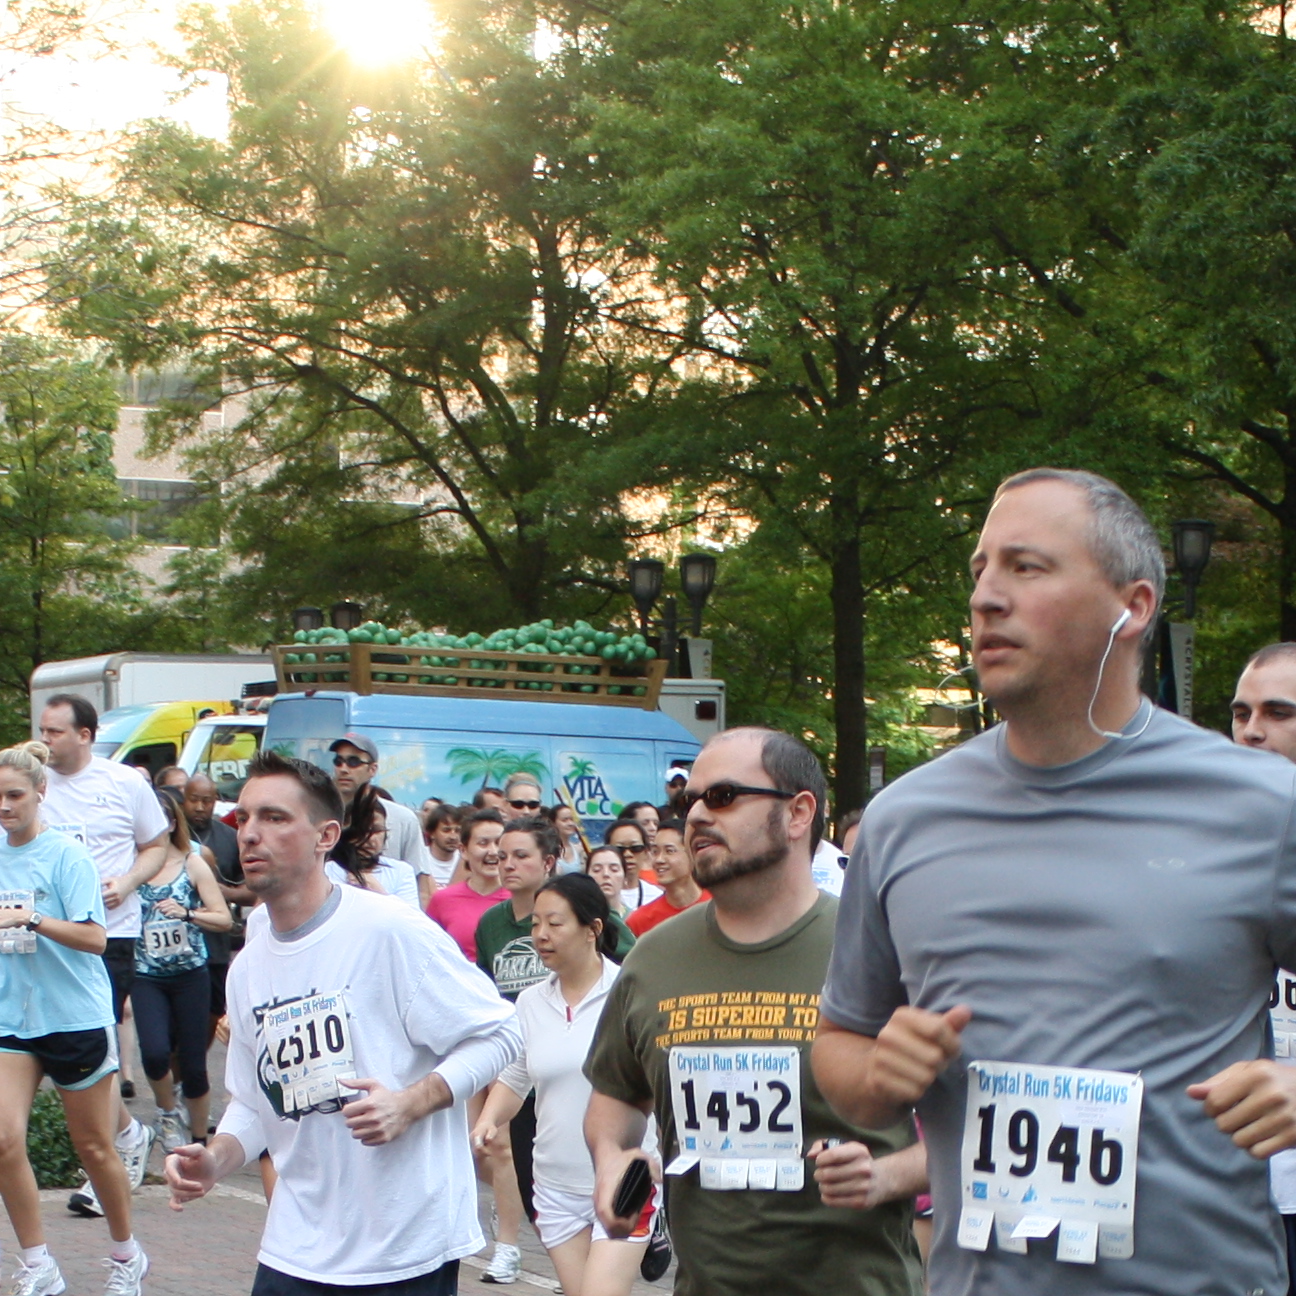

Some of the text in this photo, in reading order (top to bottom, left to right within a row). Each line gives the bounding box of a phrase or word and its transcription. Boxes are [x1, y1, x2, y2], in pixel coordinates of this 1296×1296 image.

[563, 775, 610, 801] VITA
[151, 929, 182, 949] 316
[658, 997, 676, 1012] THE
[678, 993, 718, 1008] SPORTS
[721, 991, 752, 1005] TEAM
[755, 991, 786, 1005] FROM
[789, 993, 806, 1005] MY
[668, 1005, 818, 1031] IS SUPERIOR TO
[276, 1014, 345, 1070] 2510
[655, 1033, 671, 1049] THE
[672, 1029, 710, 1044] SPORTS
[713, 1028, 743, 1040] TEAM
[745, 1027, 774, 1040] FROM
[777, 1029, 803, 1041] YOUR
[677, 1052, 791, 1075] Crystal Run 5K Fridays
[978, 1069, 1129, 1105] Crystal Run 5K Fridays
[680, 1079, 794, 1134] 1452
[972, 1103, 1124, 1187] 1946
